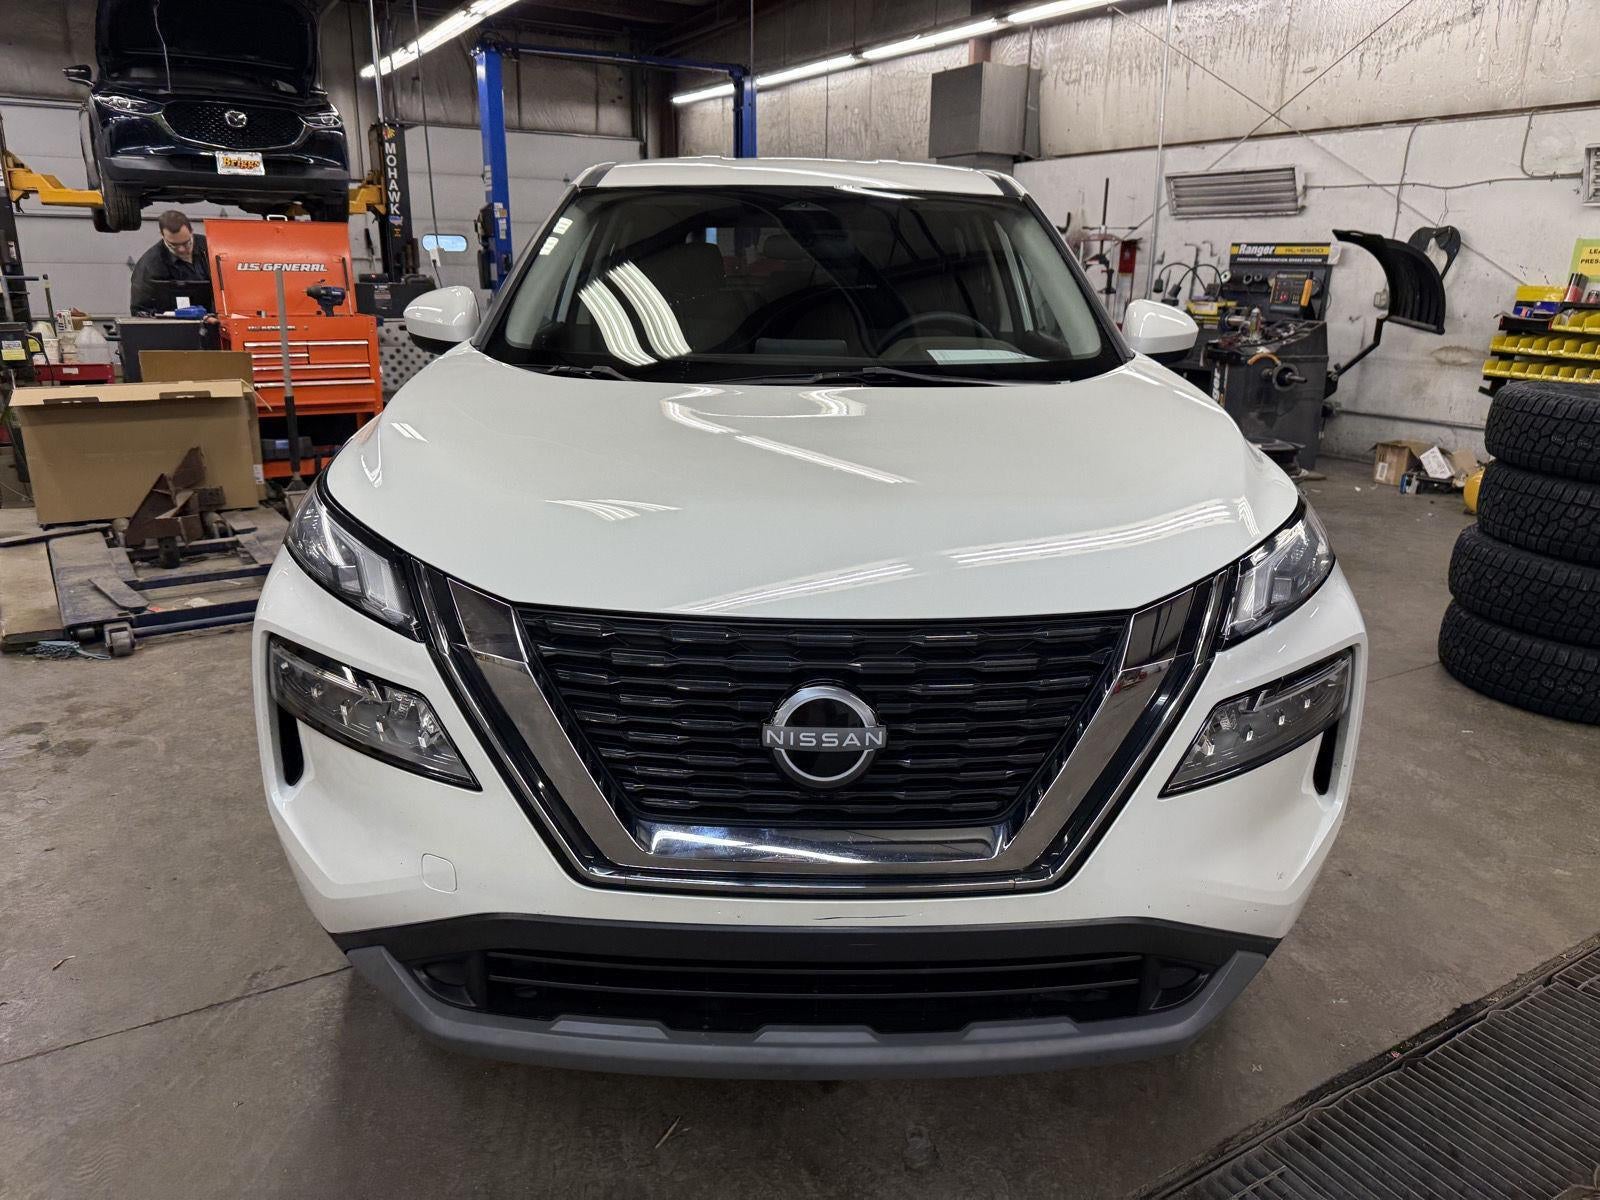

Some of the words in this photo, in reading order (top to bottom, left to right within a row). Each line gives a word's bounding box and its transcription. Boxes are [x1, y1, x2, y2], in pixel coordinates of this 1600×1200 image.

[222, 156, 261, 170] Briggs
[385, 142, 400, 214] MOHAWK
[1239, 244, 1275, 256] Ranger
[262, 263, 328, 272] GENERAL
[766, 729, 883, 747] NISSAN
